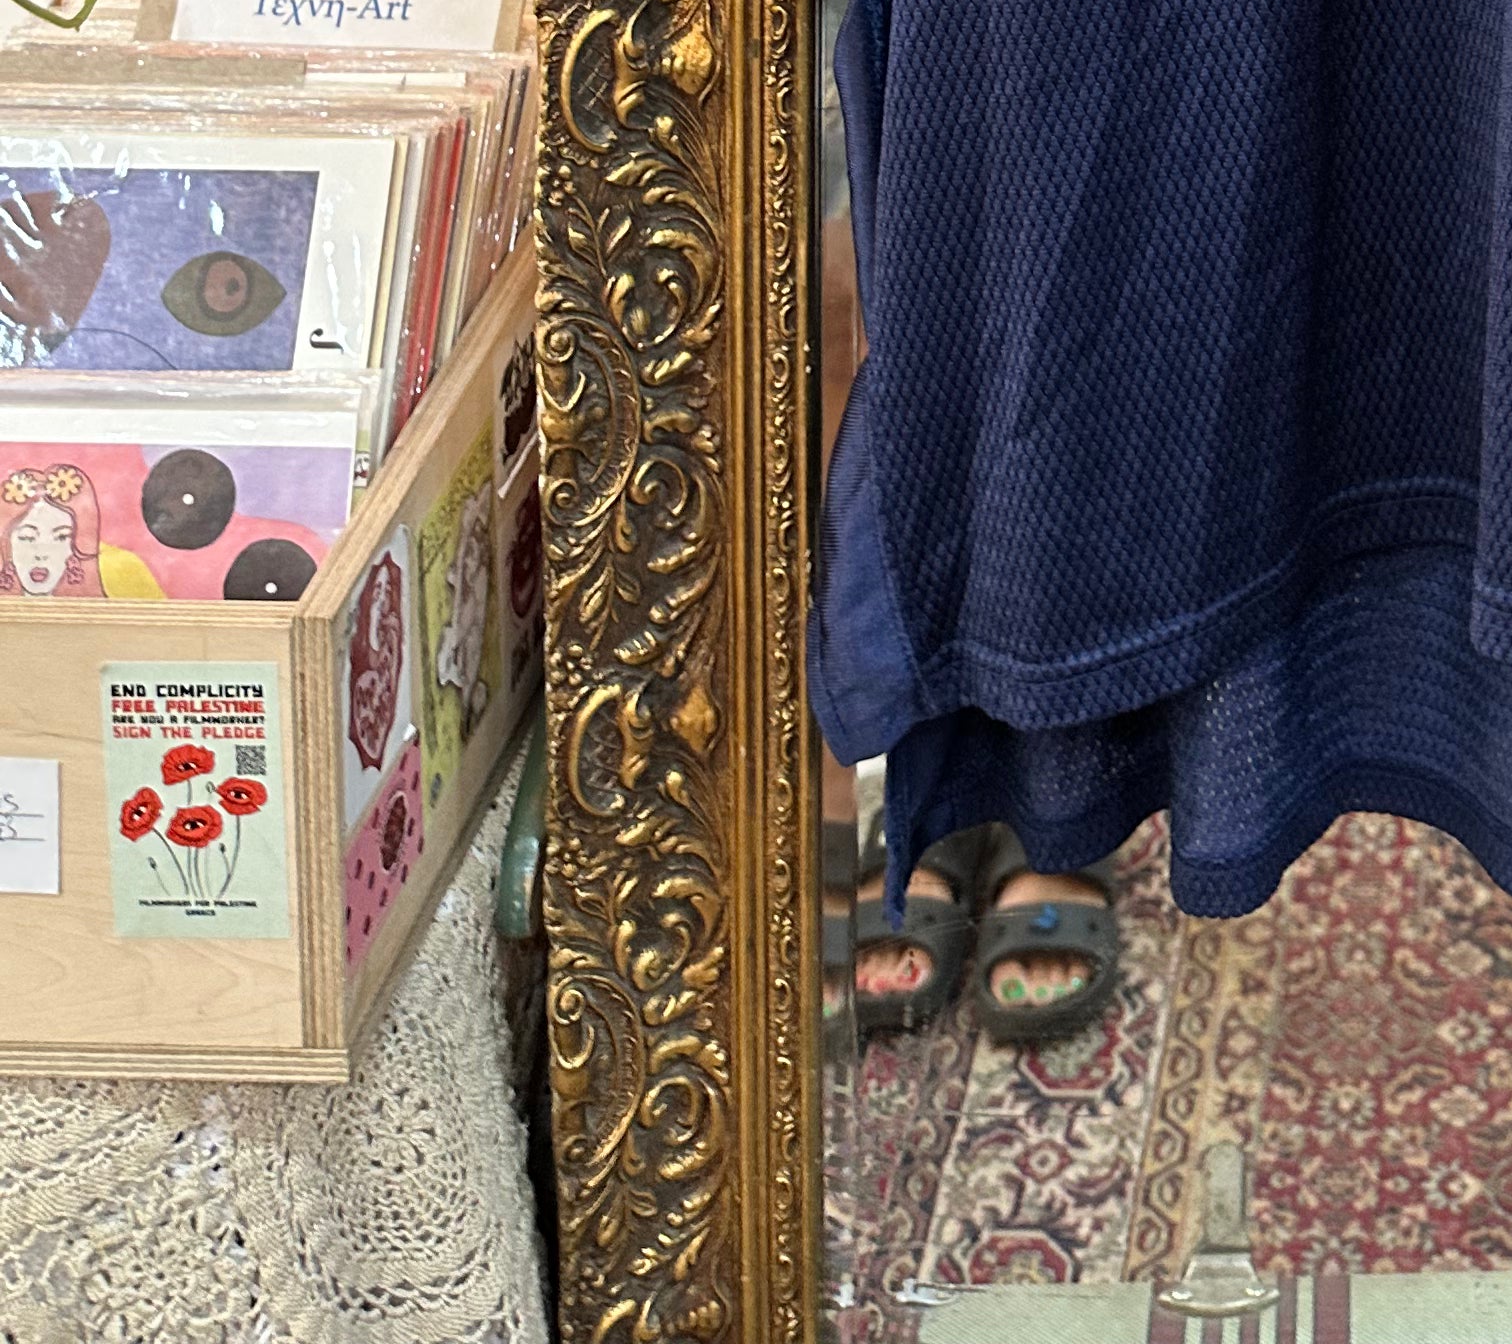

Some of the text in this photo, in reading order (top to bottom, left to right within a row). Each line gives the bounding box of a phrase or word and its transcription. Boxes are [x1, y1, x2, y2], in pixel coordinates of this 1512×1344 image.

[111, 683, 264, 698] END COMPLICITY
[111, 699, 265, 713] FREE PALESTINE
[112, 726, 266, 739] SIGN THE PLEDGE
